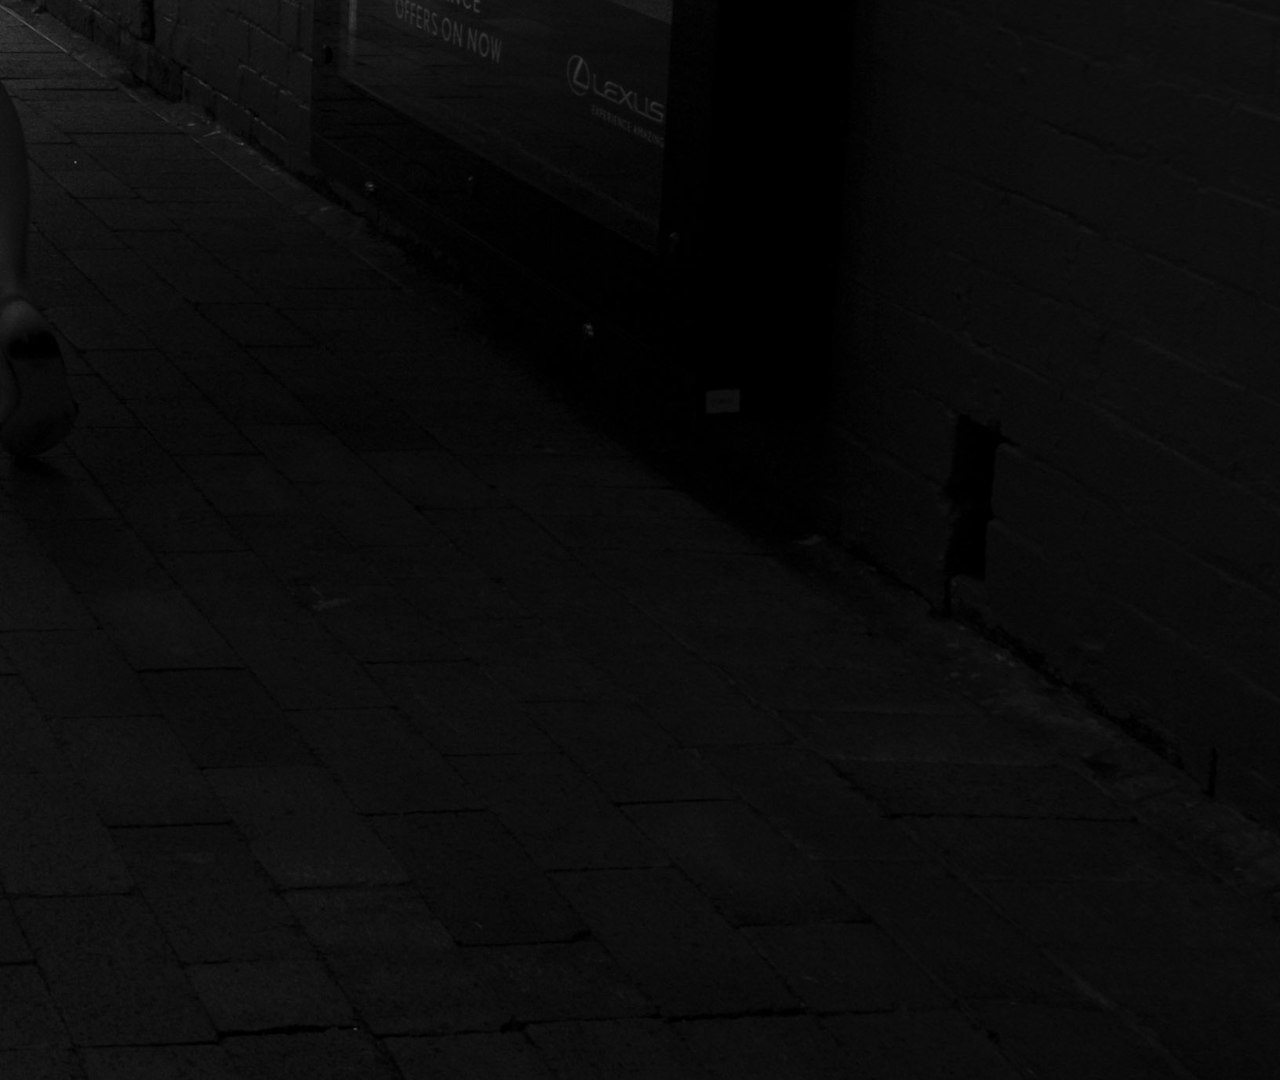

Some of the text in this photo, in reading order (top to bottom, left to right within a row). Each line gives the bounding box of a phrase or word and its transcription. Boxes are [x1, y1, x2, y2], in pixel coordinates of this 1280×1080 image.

[441, 17, 463, 48] ON
[467, 27, 502, 64] NOW
[593, 73, 665, 123] LEXUS
